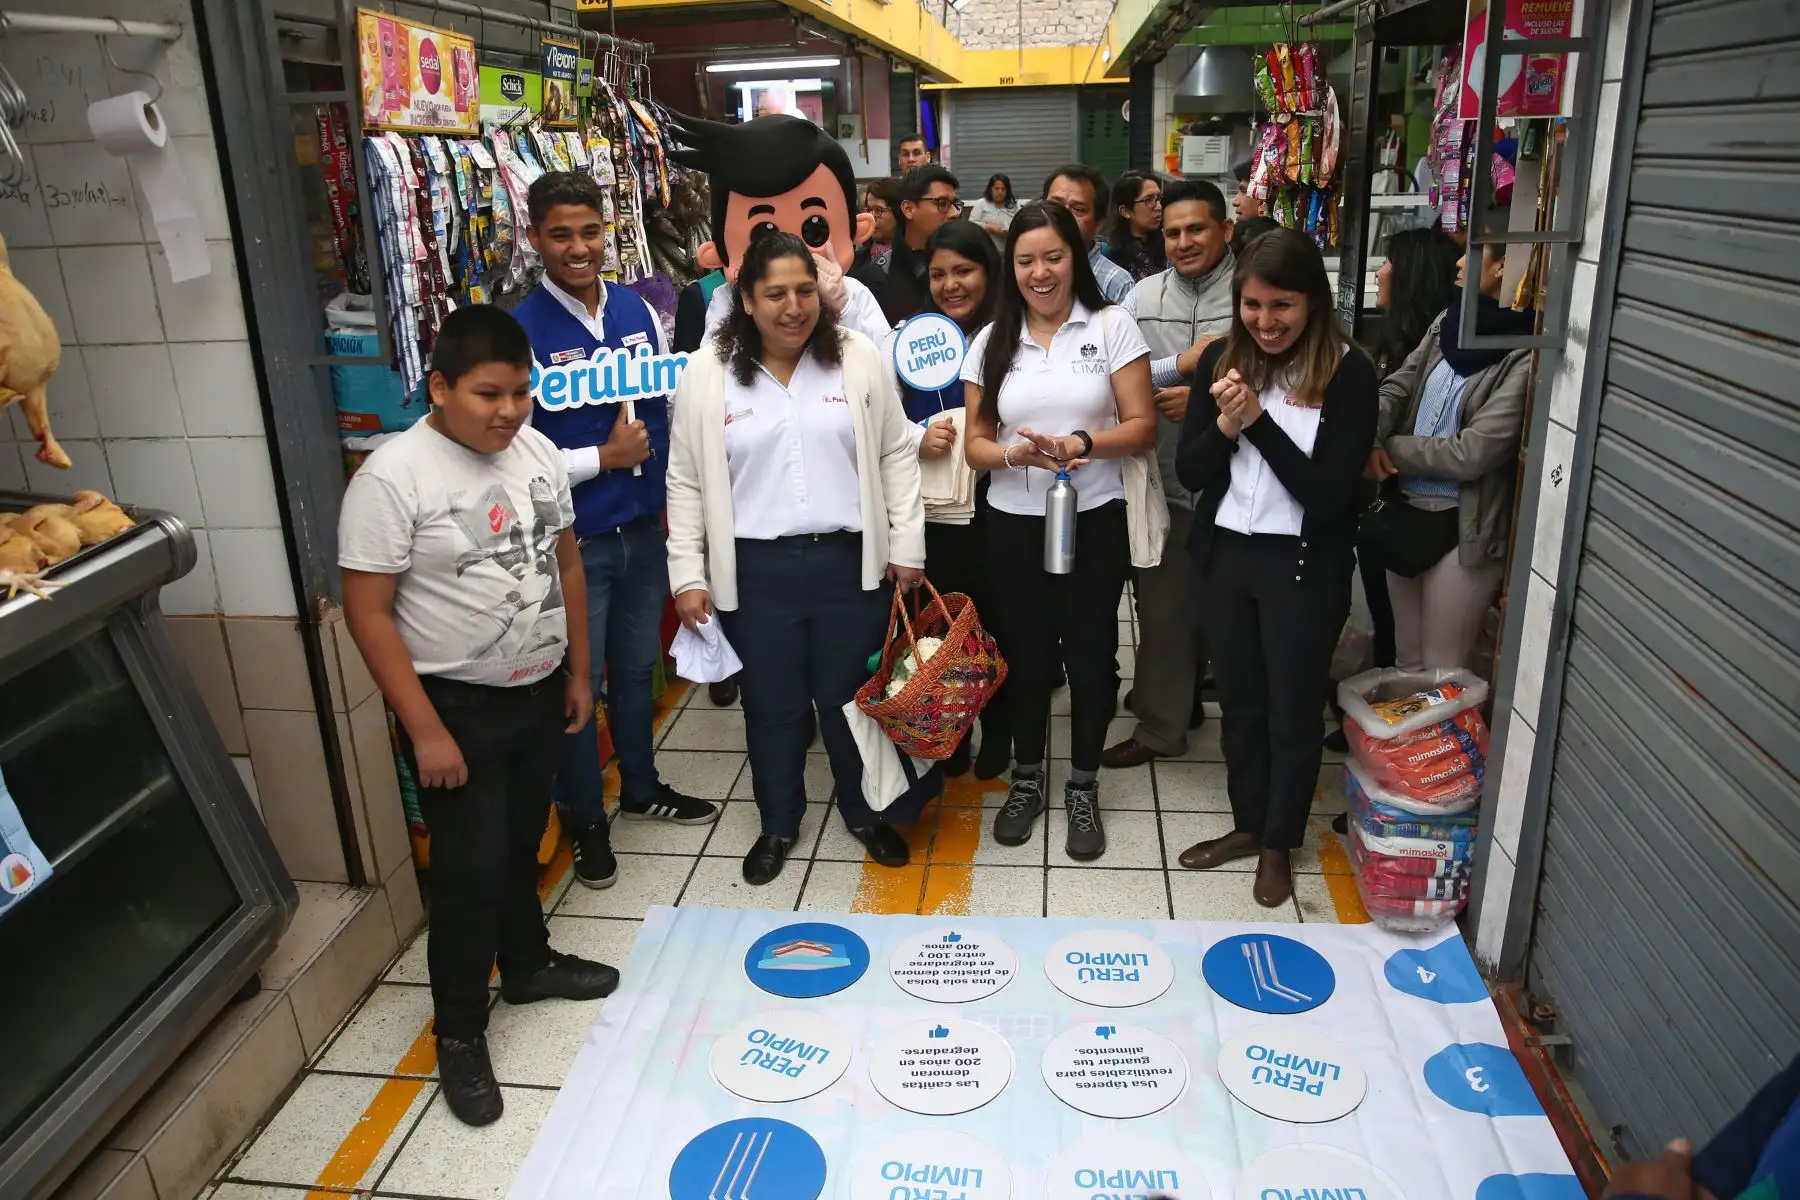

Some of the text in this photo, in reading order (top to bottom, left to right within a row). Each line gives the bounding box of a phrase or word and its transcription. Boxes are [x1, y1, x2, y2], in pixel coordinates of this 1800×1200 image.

[1522, 2, 1571, 12] REMUEVE
[420, 55, 440, 70] sedal
[552, 47, 576, 69] Rexona
[502, 77, 522, 93] Schick
[1000, 76, 1014, 85] 109
[413, 99, 433, 112] NUEVO
[319, 122, 329, 152] KIRMA
[339, 151, 350, 181] KIRMA
[332, 199, 346, 227] KIRMA
[908, 327, 947, 355] PERÚ
[906, 347, 957, 373] LIMPIO
[1072, 363, 1107, 375] LIMA
[507, 666, 537, 682] NIKE
[1408, 740, 1456, 763] mimaskot
[1420, 760, 1467, 784] mimaskot
[1399, 847, 1448, 858] mimaskot
[921, 943, 953, 951] años.
[908, 960, 977, 968] degradarse
[1065, 951, 1149, 967] LIMPIO
[942, 968, 991, 977] plástico
[1077, 968, 1141, 984] PERÚ
[1415, 965, 1437, 984] 4
[971, 978, 996, 986] Una
[746, 1028, 831, 1065] LIMPIO
[900, 1046, 980, 1056] degradarse.
[1074, 1046, 1144, 1056] alimentos.
[740, 1048, 807, 1079] PERÚ
[919, 1059, 951, 1067] años
[954, 1058, 981, 1066] 200
[1073, 1056, 1151, 1067] guardar tus
[1245, 1045, 1341, 1081] LIMPIO
[911, 1069, 970, 1077] demoran
[1055, 1068, 1173, 1078] reutilizables para
[1251, 1065, 1324, 1097] PERÚ
[1465, 1066, 1490, 1092] 3
[902, 1080, 980, 1090] Las cañitas
[1075, 1080, 1158, 1089] Usa táperes
[880, 1160, 983, 1189] LIMPIO
[1074, 1168, 1180, 1190] LIMPIO
